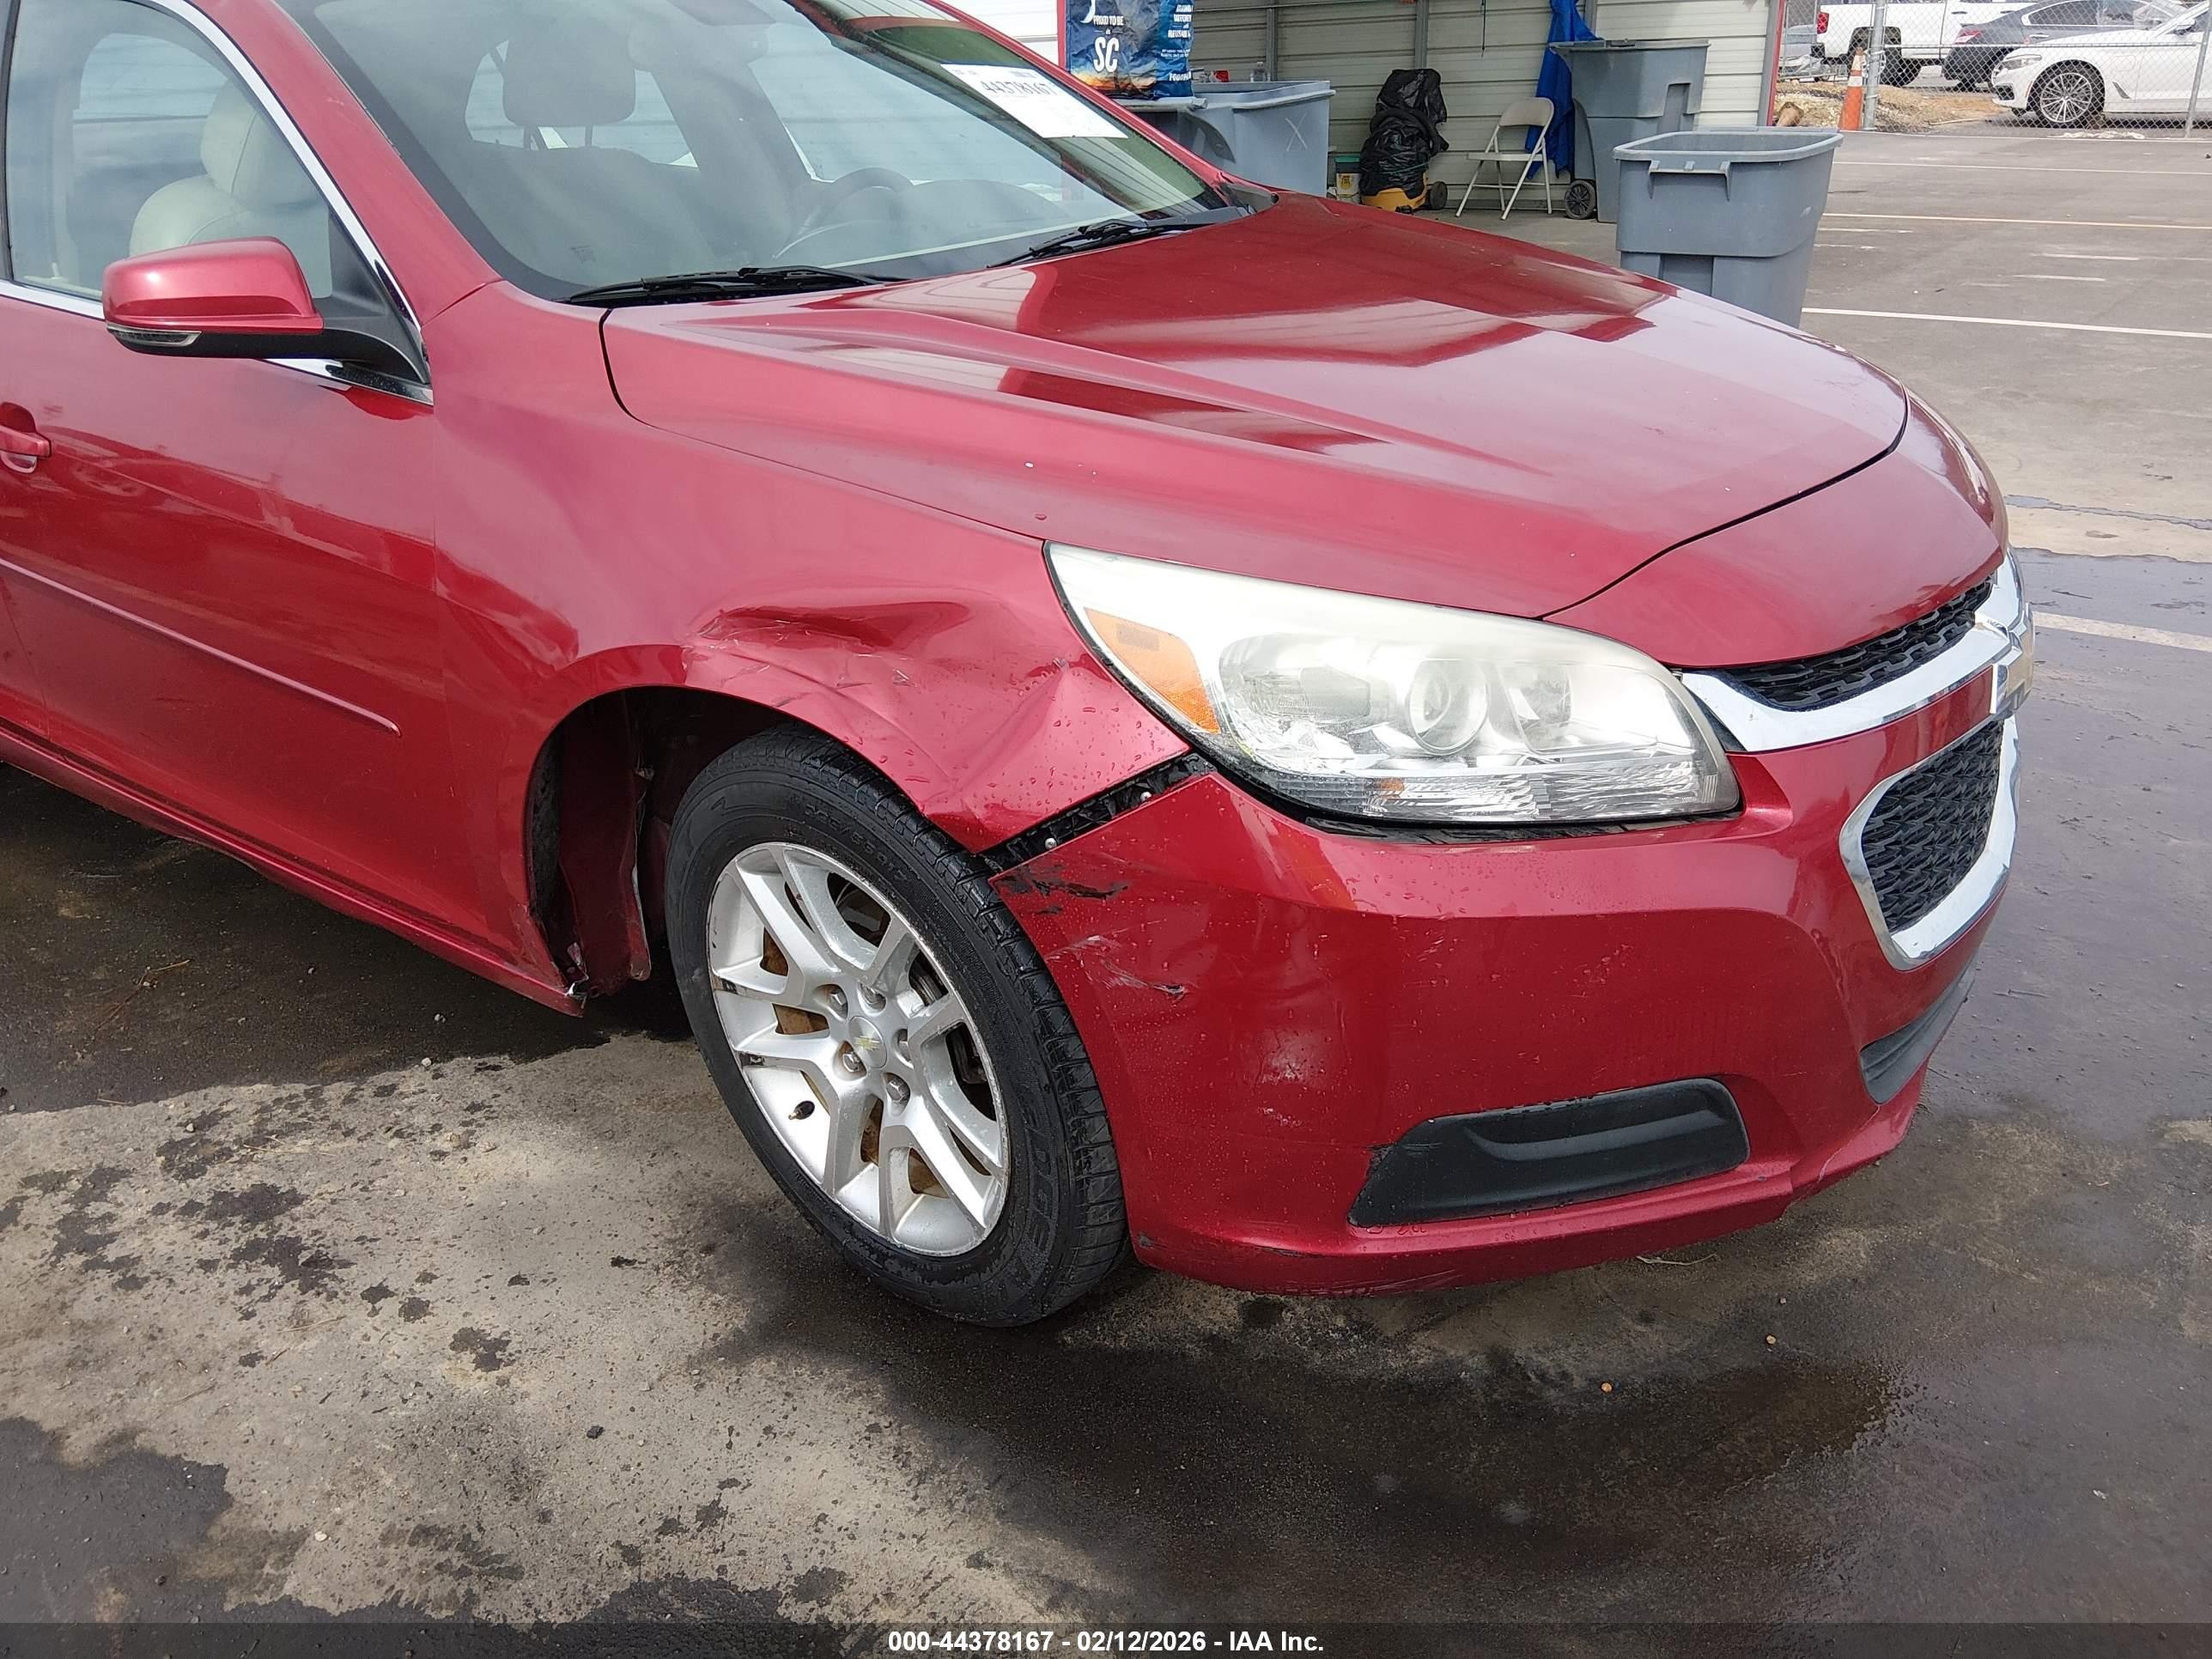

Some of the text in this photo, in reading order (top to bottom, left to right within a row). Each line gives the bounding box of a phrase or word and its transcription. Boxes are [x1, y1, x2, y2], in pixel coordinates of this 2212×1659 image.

[1109, 15, 1116, 26] TO
[1093, 36, 1120, 72] SC
[980, 81, 1058, 96] 44378167
